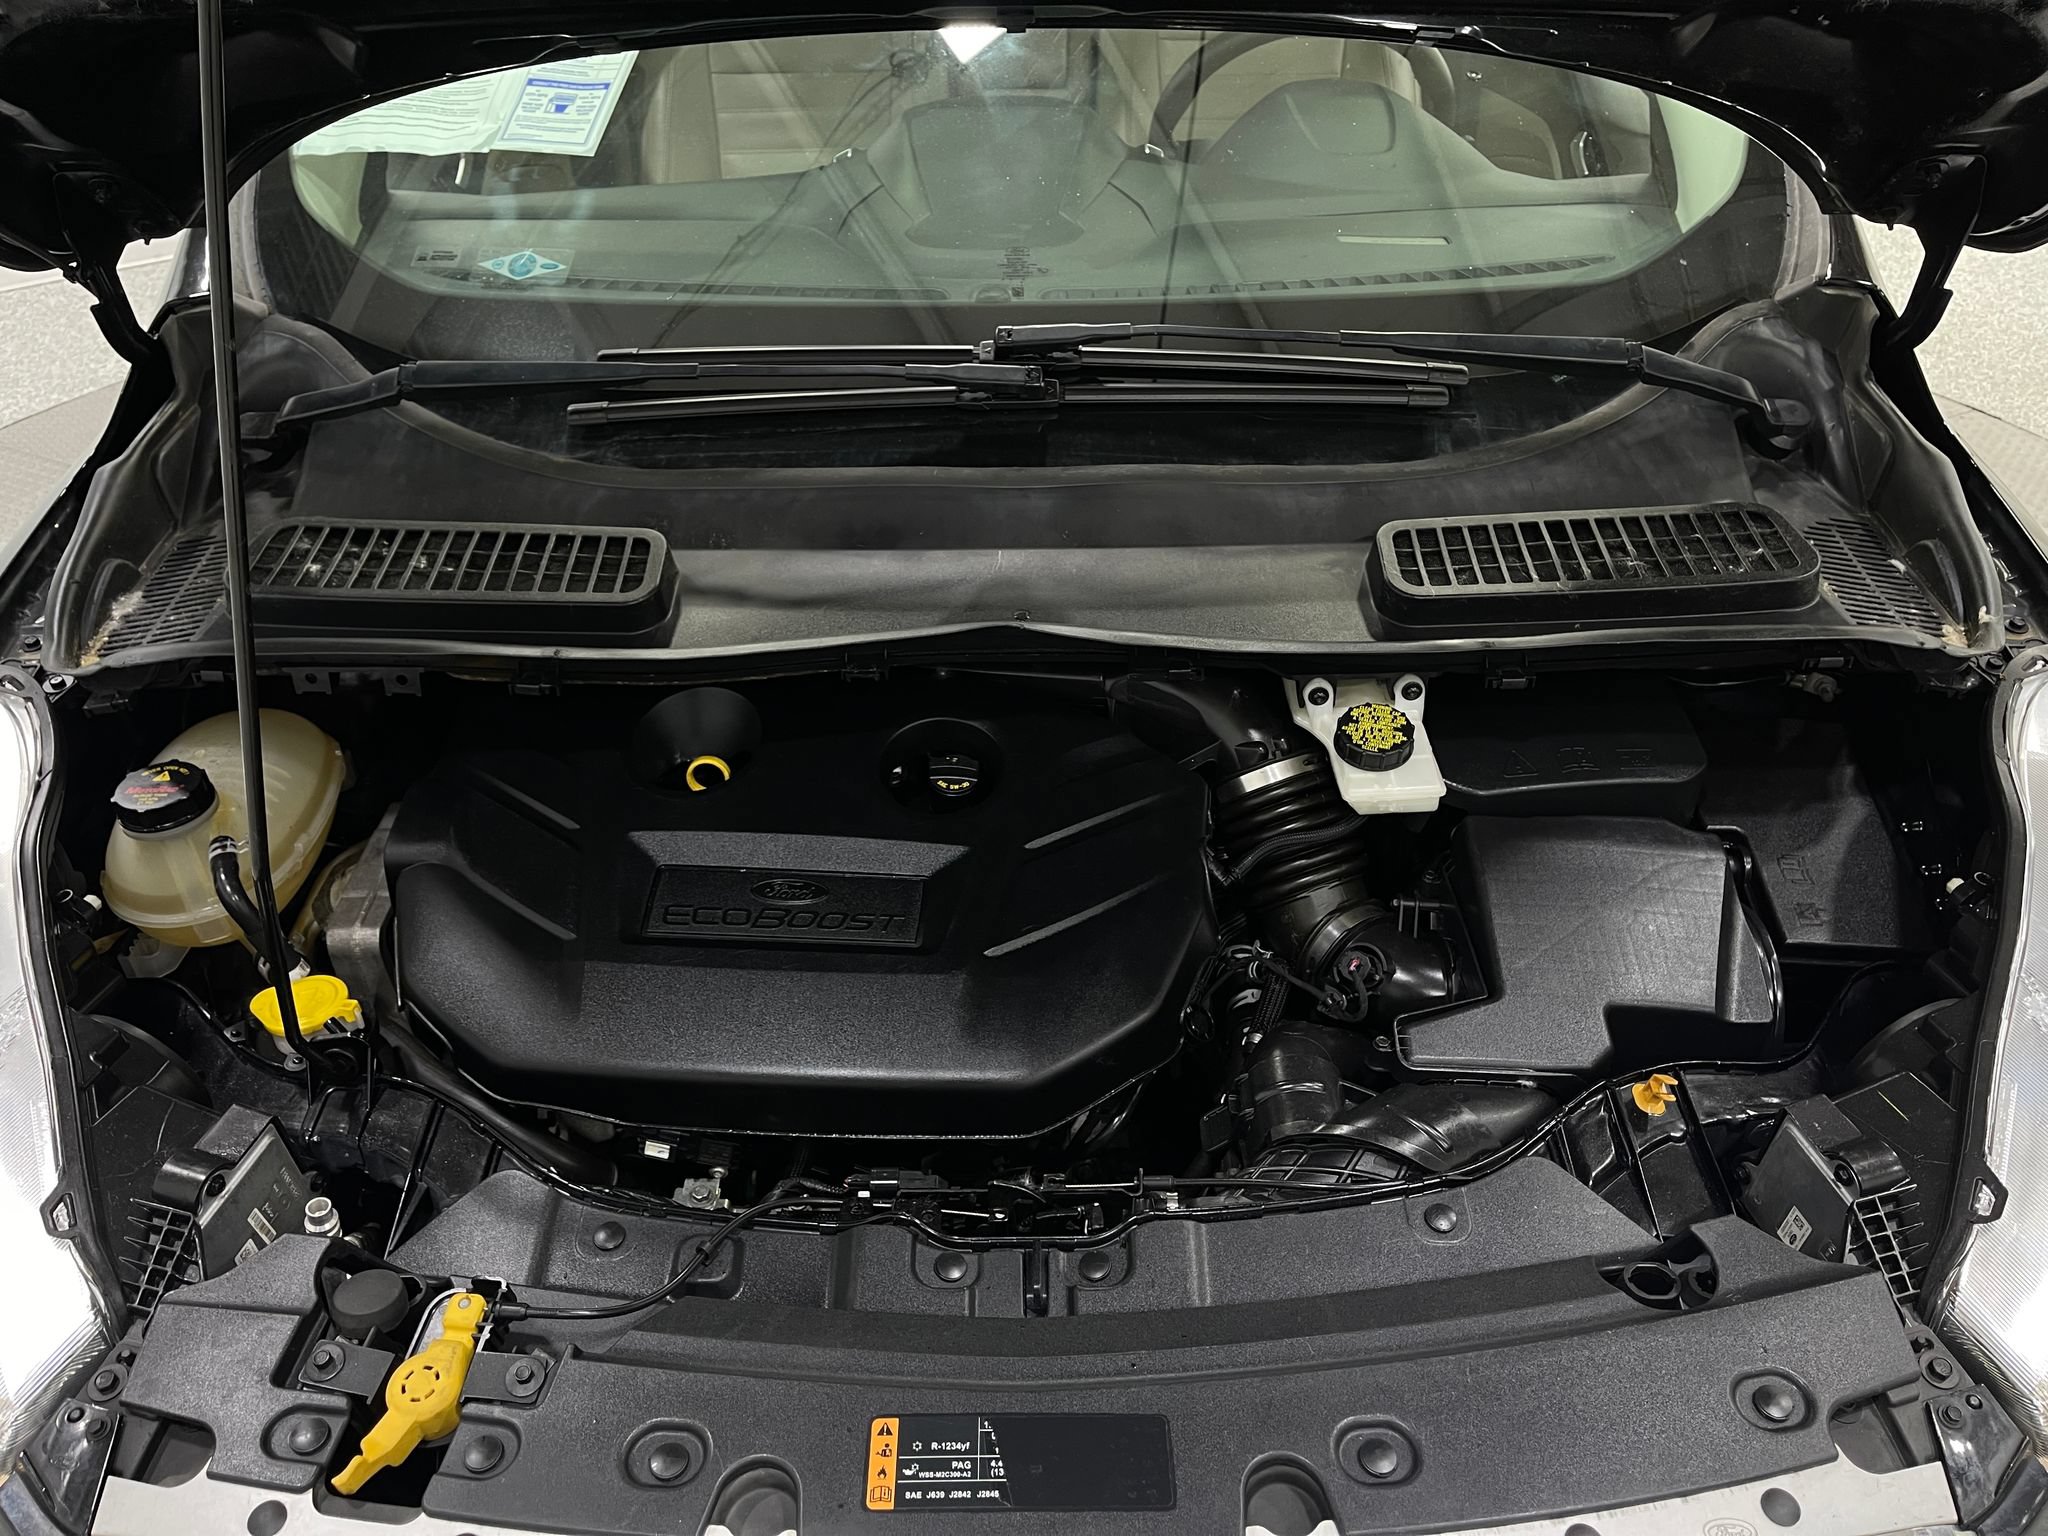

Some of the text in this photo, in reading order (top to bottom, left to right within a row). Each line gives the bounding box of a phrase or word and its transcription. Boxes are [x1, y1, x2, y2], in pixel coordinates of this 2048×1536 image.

[763, 880, 816, 900] Ford
[663, 905, 906, 933] ECOBOOST
[931, 1441, 971, 1452] R-1234yf
[951, 1461, 972, 1469] PAG
[905, 1491, 922, 1499] SAE
[926, 1491, 945, 1499] J639
[949, 1490, 971, 1499] J2842
